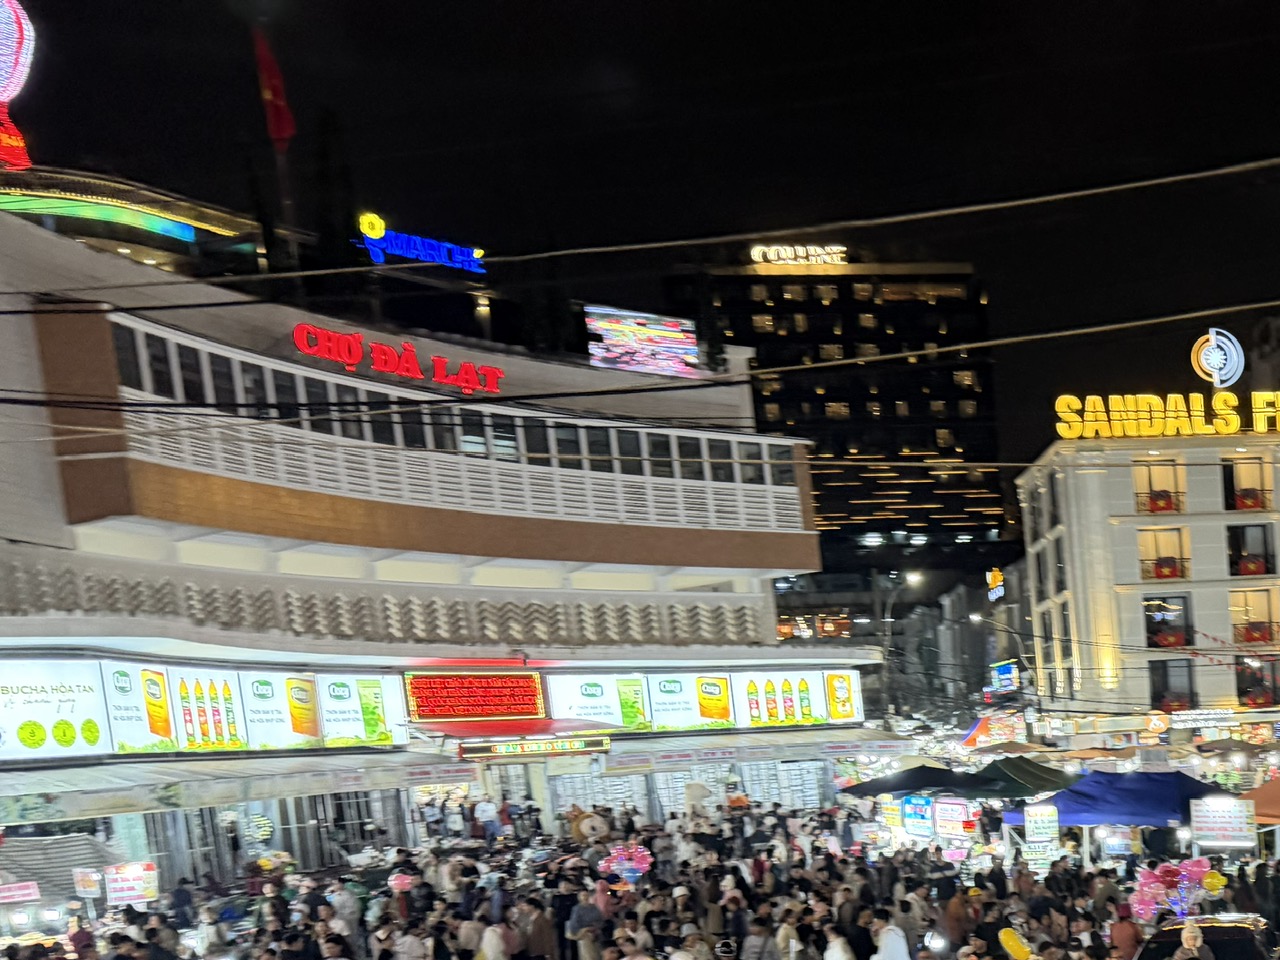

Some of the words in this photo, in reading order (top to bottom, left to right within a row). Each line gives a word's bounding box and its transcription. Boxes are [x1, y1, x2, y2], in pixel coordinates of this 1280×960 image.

[293, 323, 363, 372] CHỢ
[369, 342, 425, 379] ĐÀ
[431, 356, 505, 395] LẠT
[1054, 391, 1241, 438] SANDALS
[51, 681, 75, 694] HÒA
[76, 684, 94, 693] TAN
